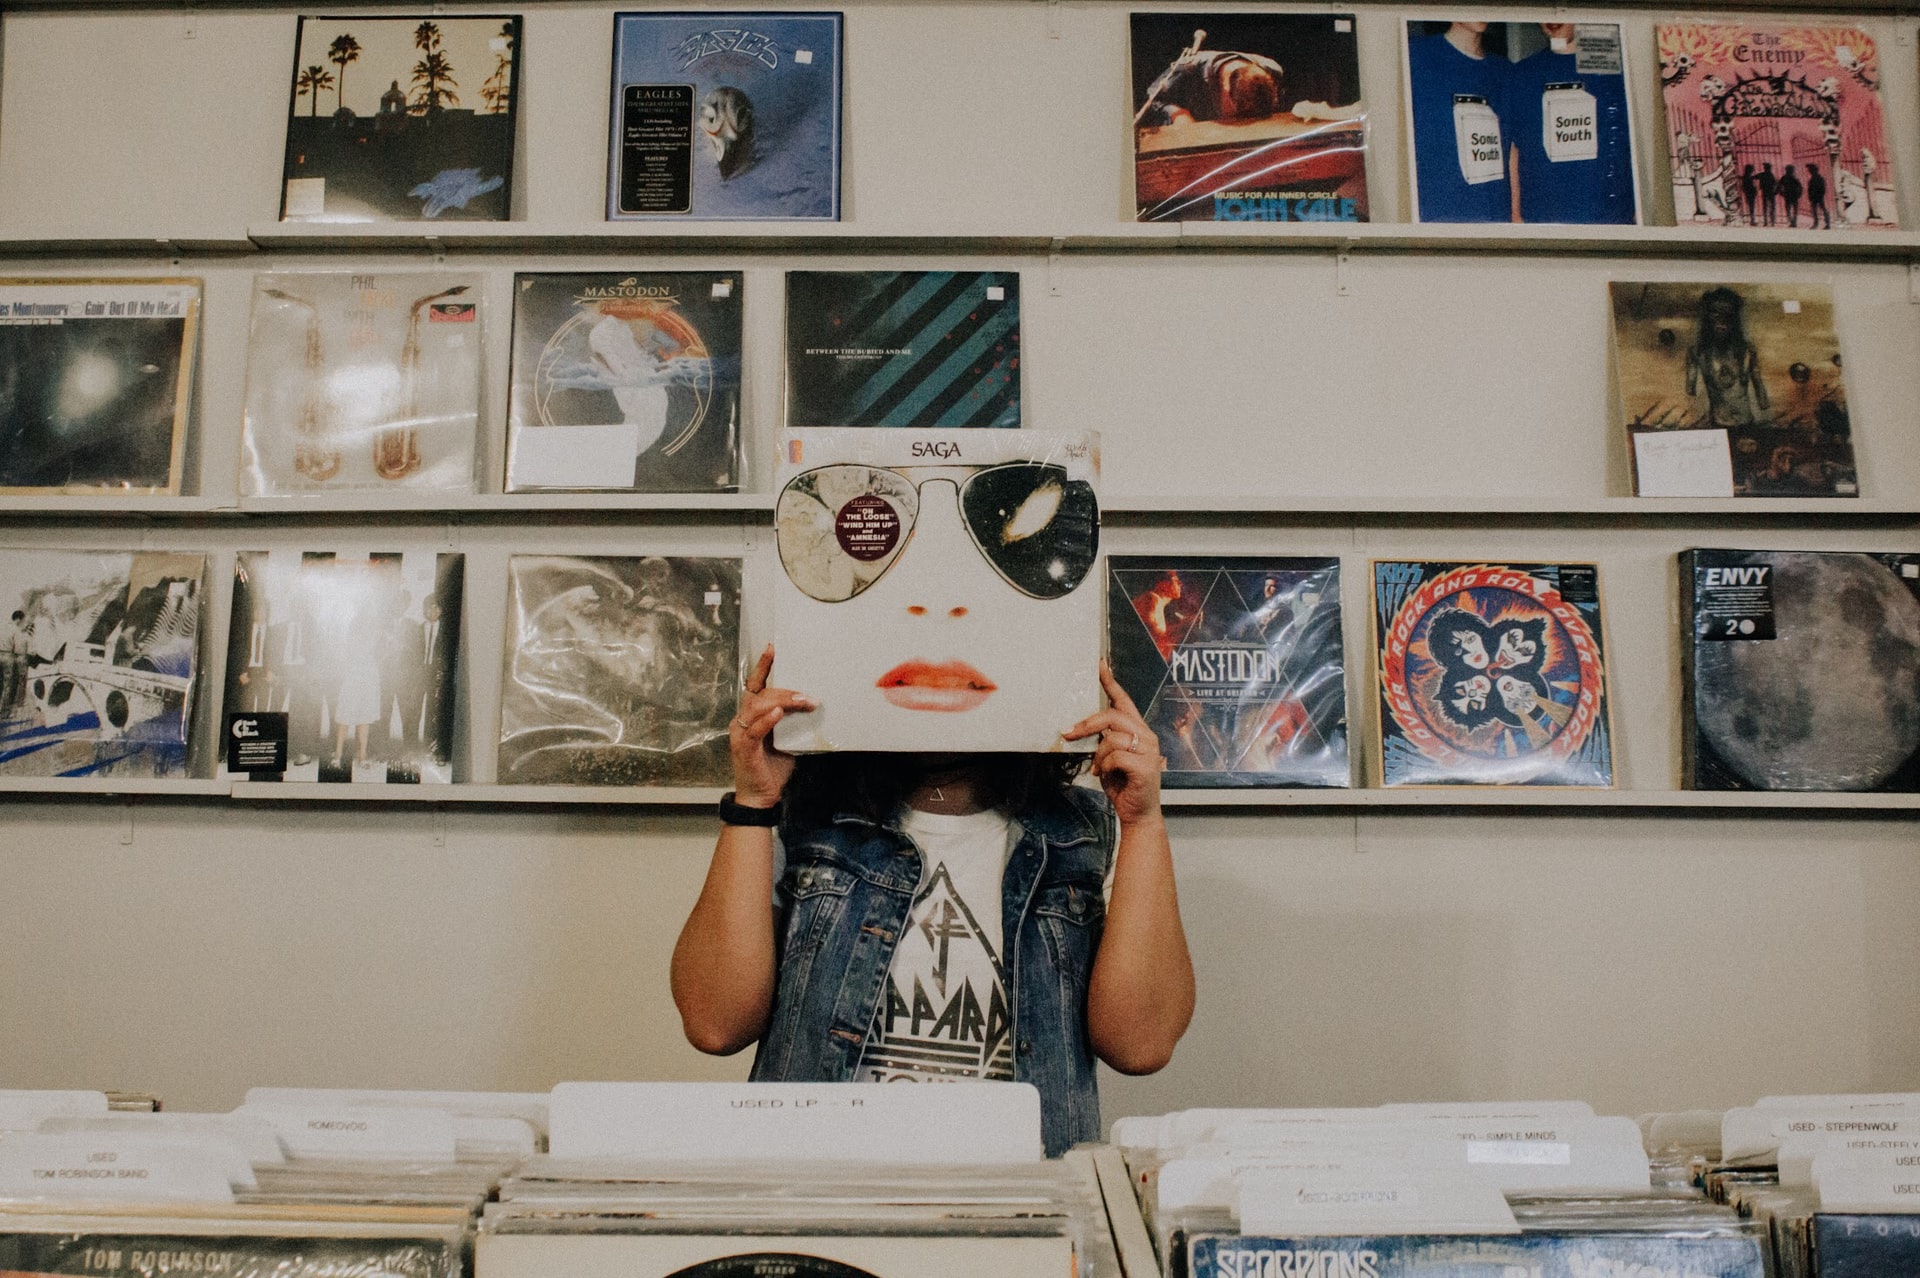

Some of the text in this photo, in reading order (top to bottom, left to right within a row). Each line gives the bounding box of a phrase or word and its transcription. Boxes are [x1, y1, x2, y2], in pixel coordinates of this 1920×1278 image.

[1751, 32, 1781, 47] The
[1733, 45, 1805, 67] Enemy
[636, 90, 682, 99] EAGLES
[1555, 116, 1591, 128] Sonic
[1471, 133, 1499, 146] Sonic
[1555, 129, 1592, 143] Youth
[1472, 148, 1500, 162] Youth
[1214, 191, 1338, 200] MUSIC FOR AN INNER CIRCLE
[1213, 197, 1359, 222] JOHN CALE
[350, 275, 377, 290] PHIL
[584, 286, 670, 297] MASTODON
[109, 302, 125, 316] Out
[127, 302, 138, 316] Of
[140, 302, 155, 316] My
[157, 301, 180, 316] Head
[911, 442, 962, 459] SAGA
[1705, 567, 1769, 586] ENVY
[1391, 596, 1427, 657] ROCK
[1433, 573, 1478, 600] AND
[1552, 607, 1592, 663] OVER
[1172, 650, 1281, 682] MASTODON
[1196, 689, 1213, 697] LIVE
[1215, 689, 1224, 697] AT
[1390, 681, 1432, 740] OVER
[1560, 686, 1593, 749] ROCK
[731, 1099, 784, 1108] USED
[795, 1099, 818, 1108] LP
[852, 1099, 864, 1108] R
[1788, 1122, 1816, 1132] USED
[1825, 1122, 1900, 1132] STEPPENWOLF
[1486, 1131, 1521, 1141] SIMPLE
[1524, 1131, 1557, 1141] MINDS
[87, 1152, 118, 1163] USED
[32, 1168, 148, 1179] TOM ROBINSON BAND
[83, 1249, 233, 1272] TOM ROBINSON
[1216, 1249, 1380, 1278] SCORPIONS
[753, 1265, 797, 1275] STEREO
